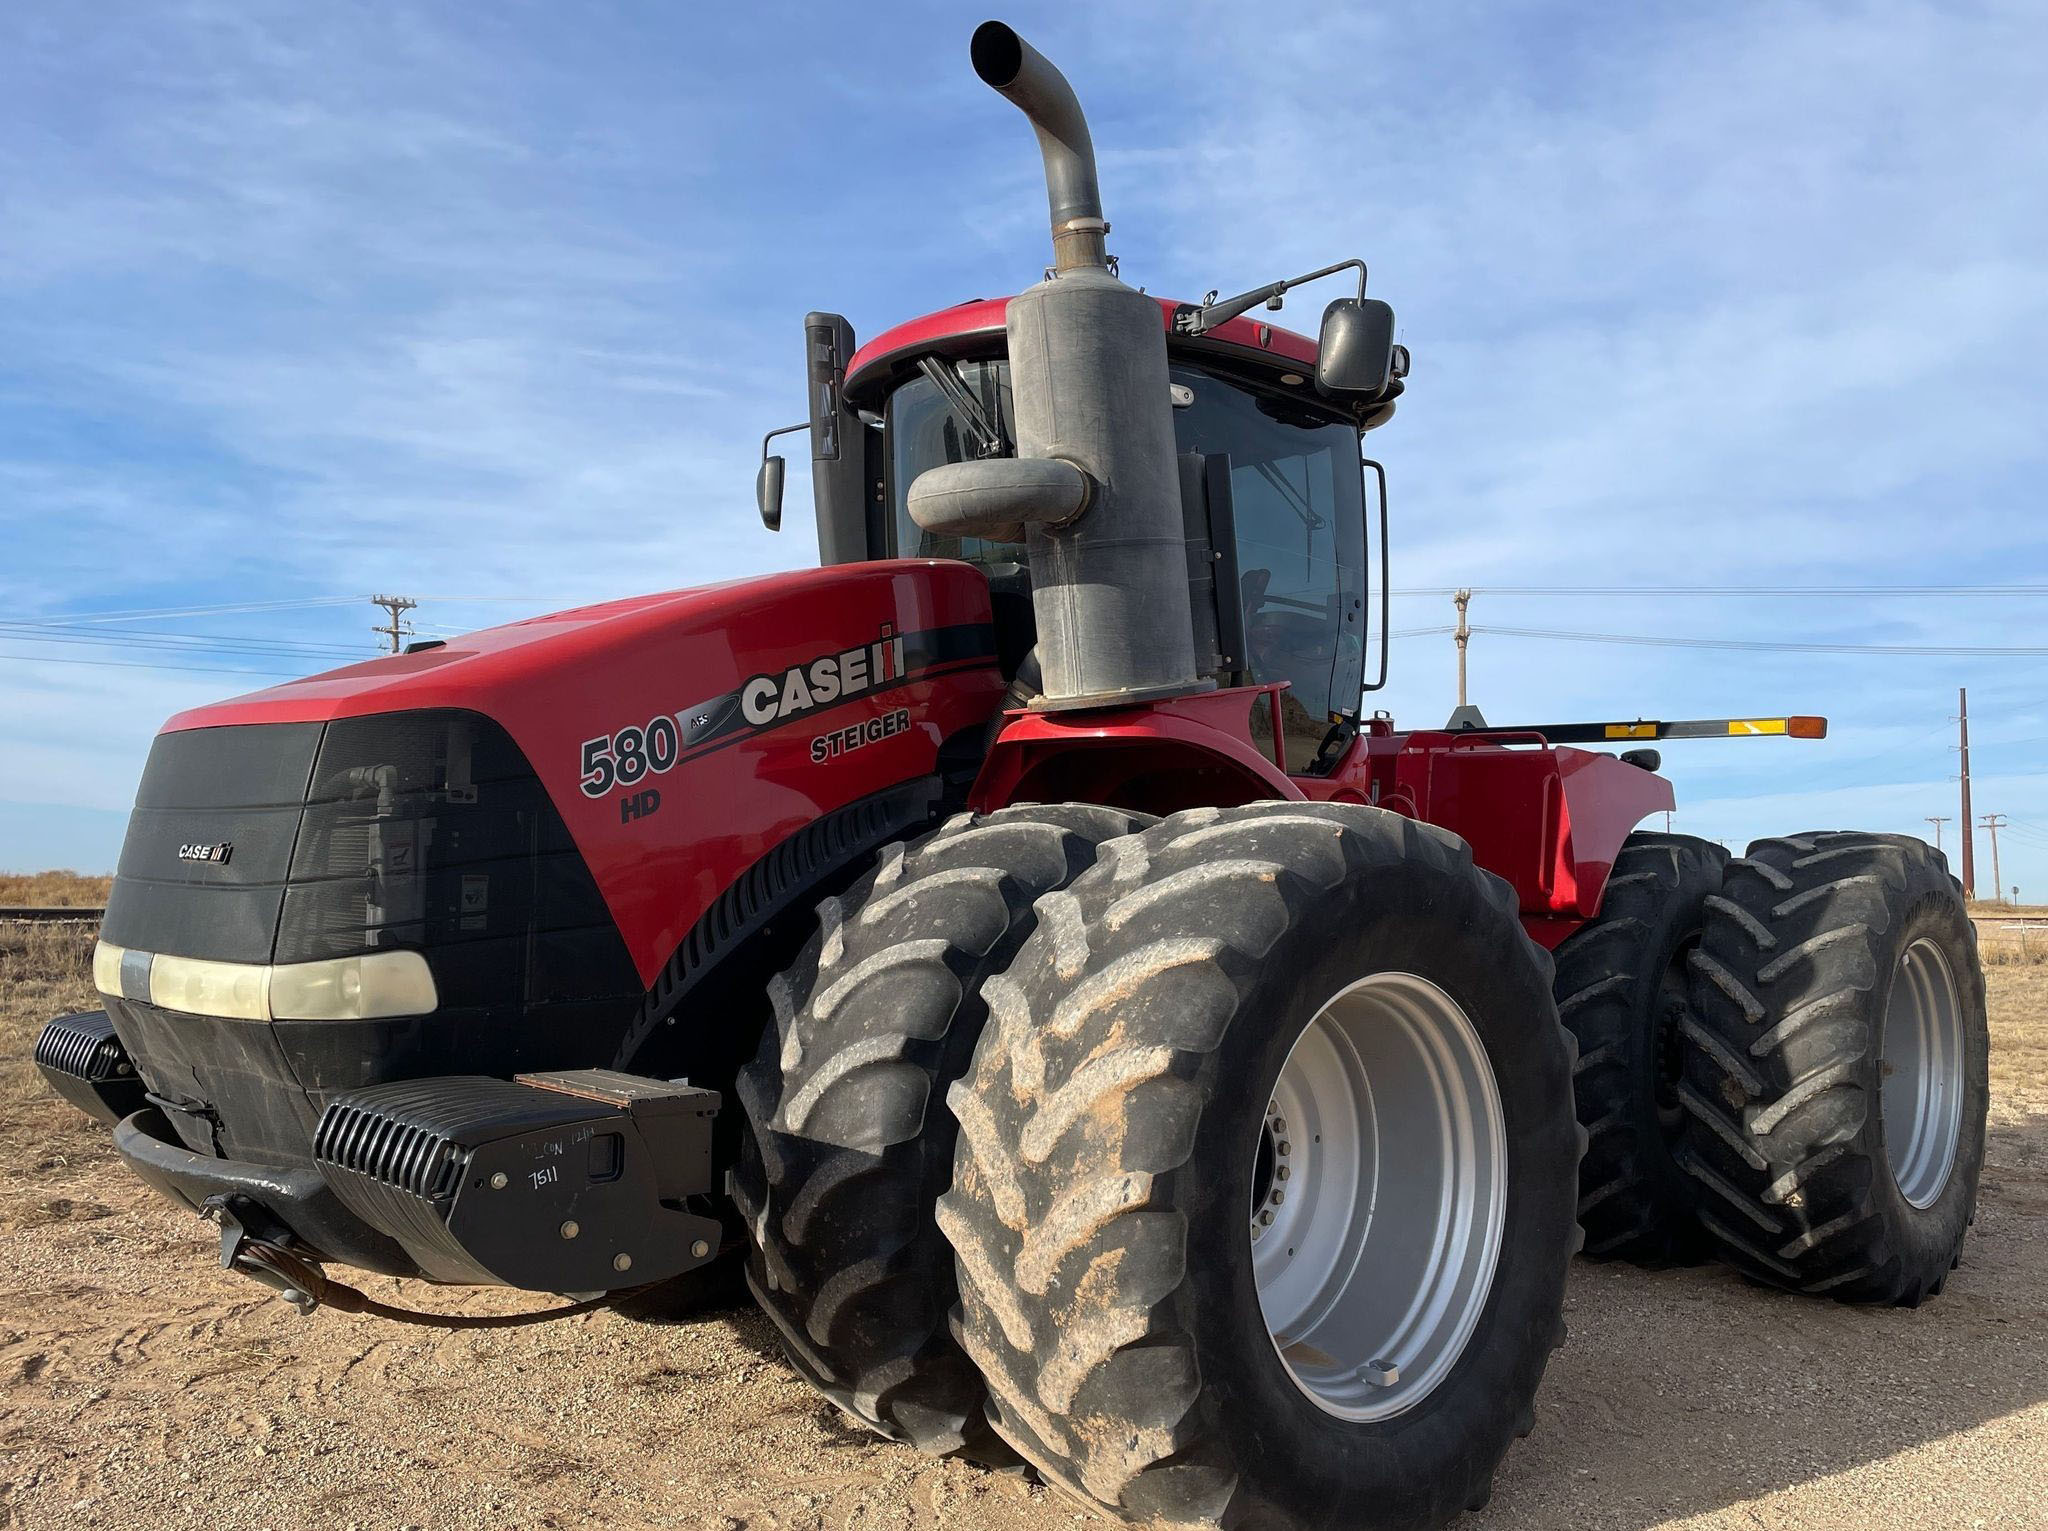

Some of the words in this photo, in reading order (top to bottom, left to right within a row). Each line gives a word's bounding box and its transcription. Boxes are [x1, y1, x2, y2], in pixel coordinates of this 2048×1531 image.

[810, 708, 912, 763] STEIGER
[580, 714, 679, 799] 580
[620, 788, 661, 824] HD
[178, 843, 211, 860] CASE
[528, 1165, 558, 1190] 7511
